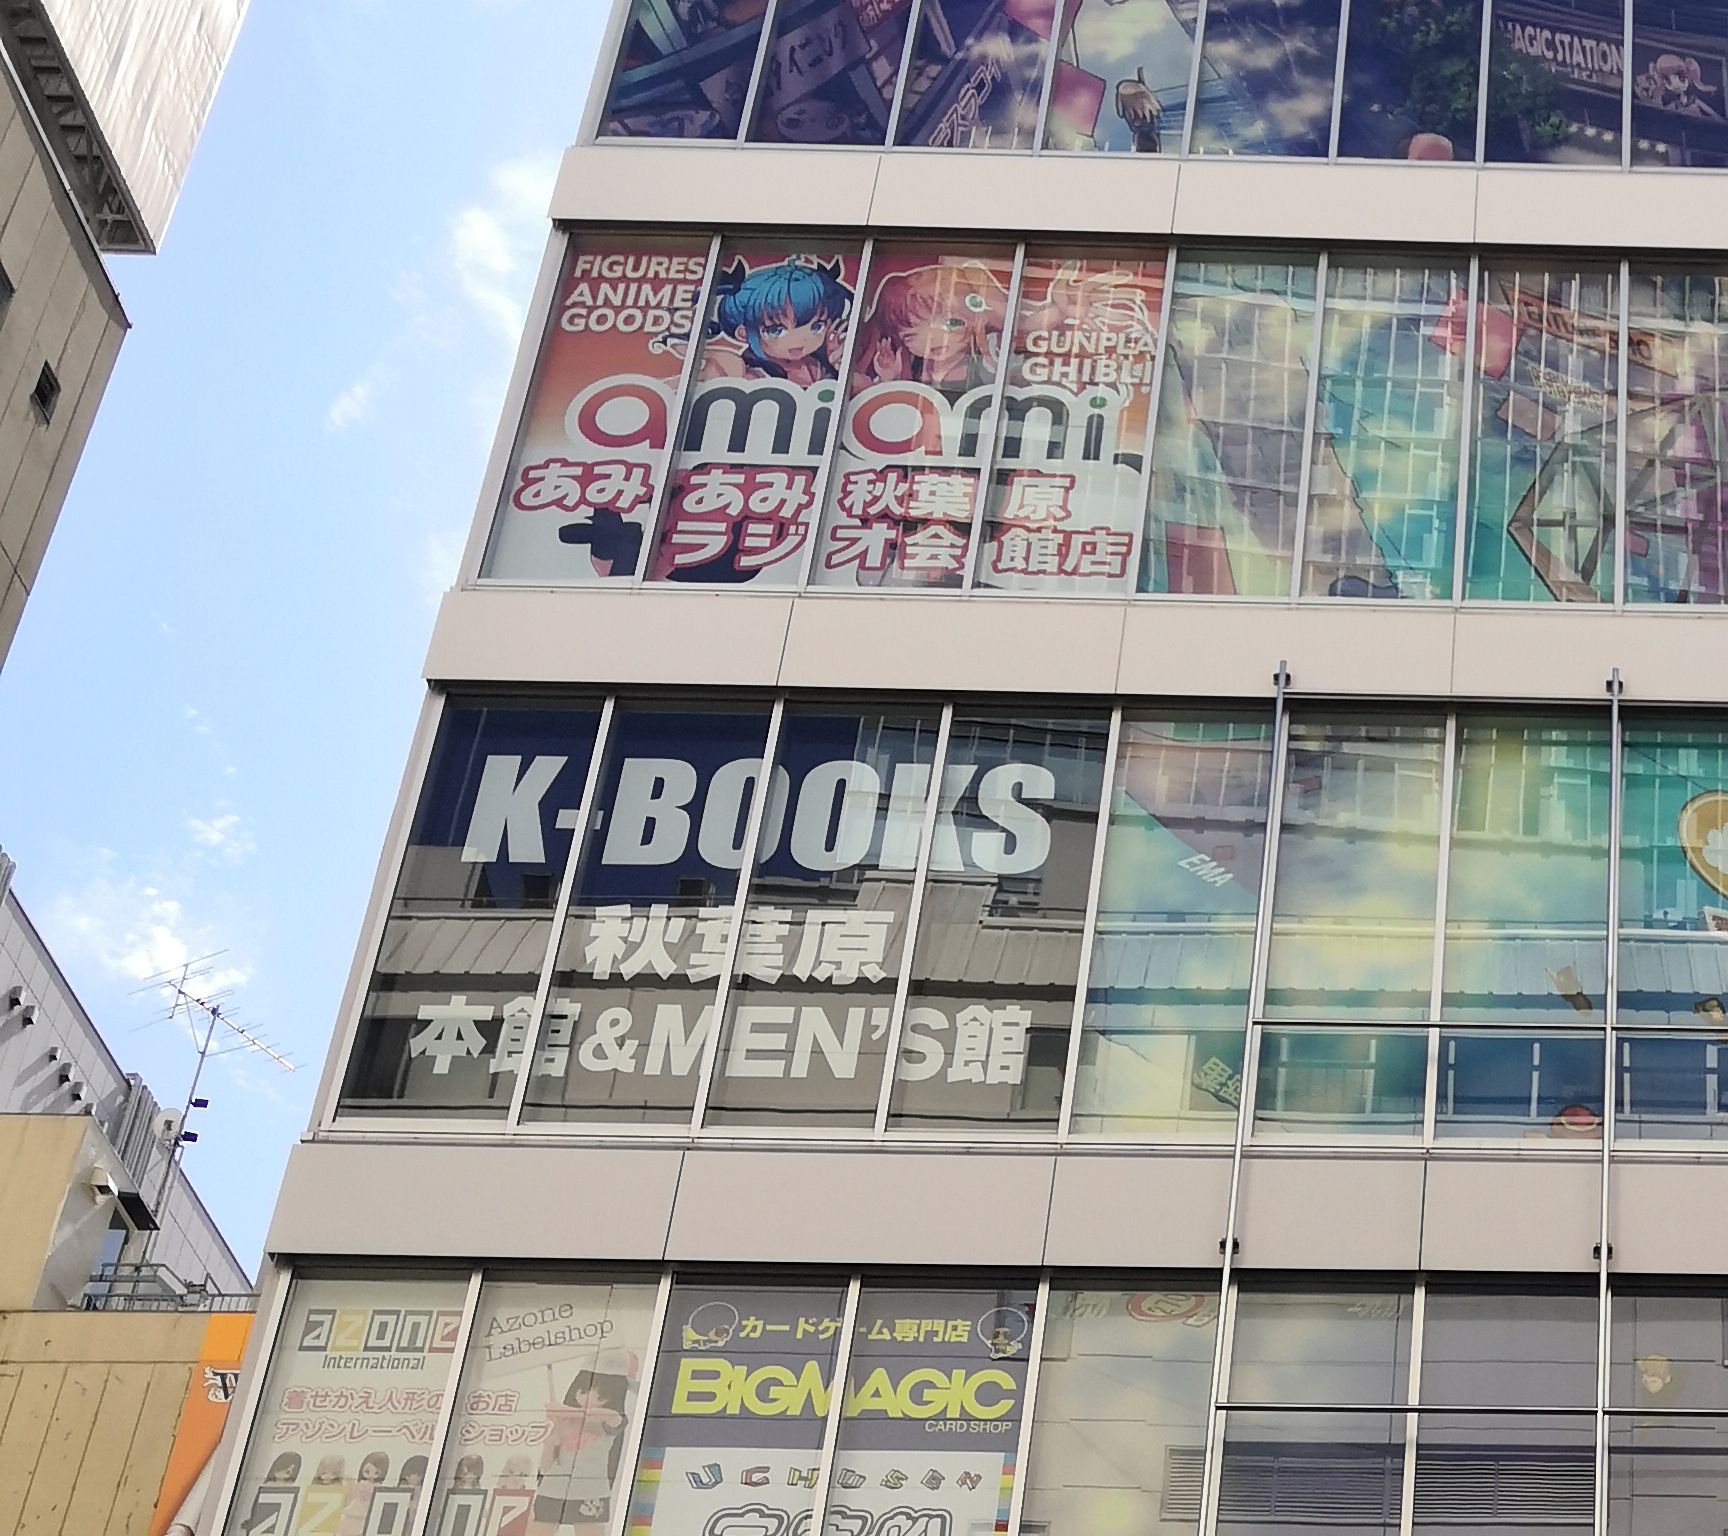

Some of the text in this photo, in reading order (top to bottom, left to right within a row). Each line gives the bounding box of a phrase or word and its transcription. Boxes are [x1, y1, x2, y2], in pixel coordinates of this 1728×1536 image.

[572, 254, 706, 283] FIGURES
[565, 283, 694, 310] ANIME
[560, 307, 694, 336] GOODS
[1024, 329, 1157, 357] GUNPLA
[1021, 356, 1155, 385] GHIBLI
[576, 386, 1113, 463] amiami
[516, 464, 1074, 522] あみあみ 秋葉原
[668, 520, 1132, 576] ラジオ会館店
[461, 753, 1056, 875] K-BOOKS
[583, 902, 897, 986] 秋葉原
[408, 994, 1034, 1087] 本館&MEN'S館
[485, 1300, 576, 1339] Azone
[321, 1316, 616, 1371] International Labelshop
[924, 1419, 1013, 1434] CARD SHOP
